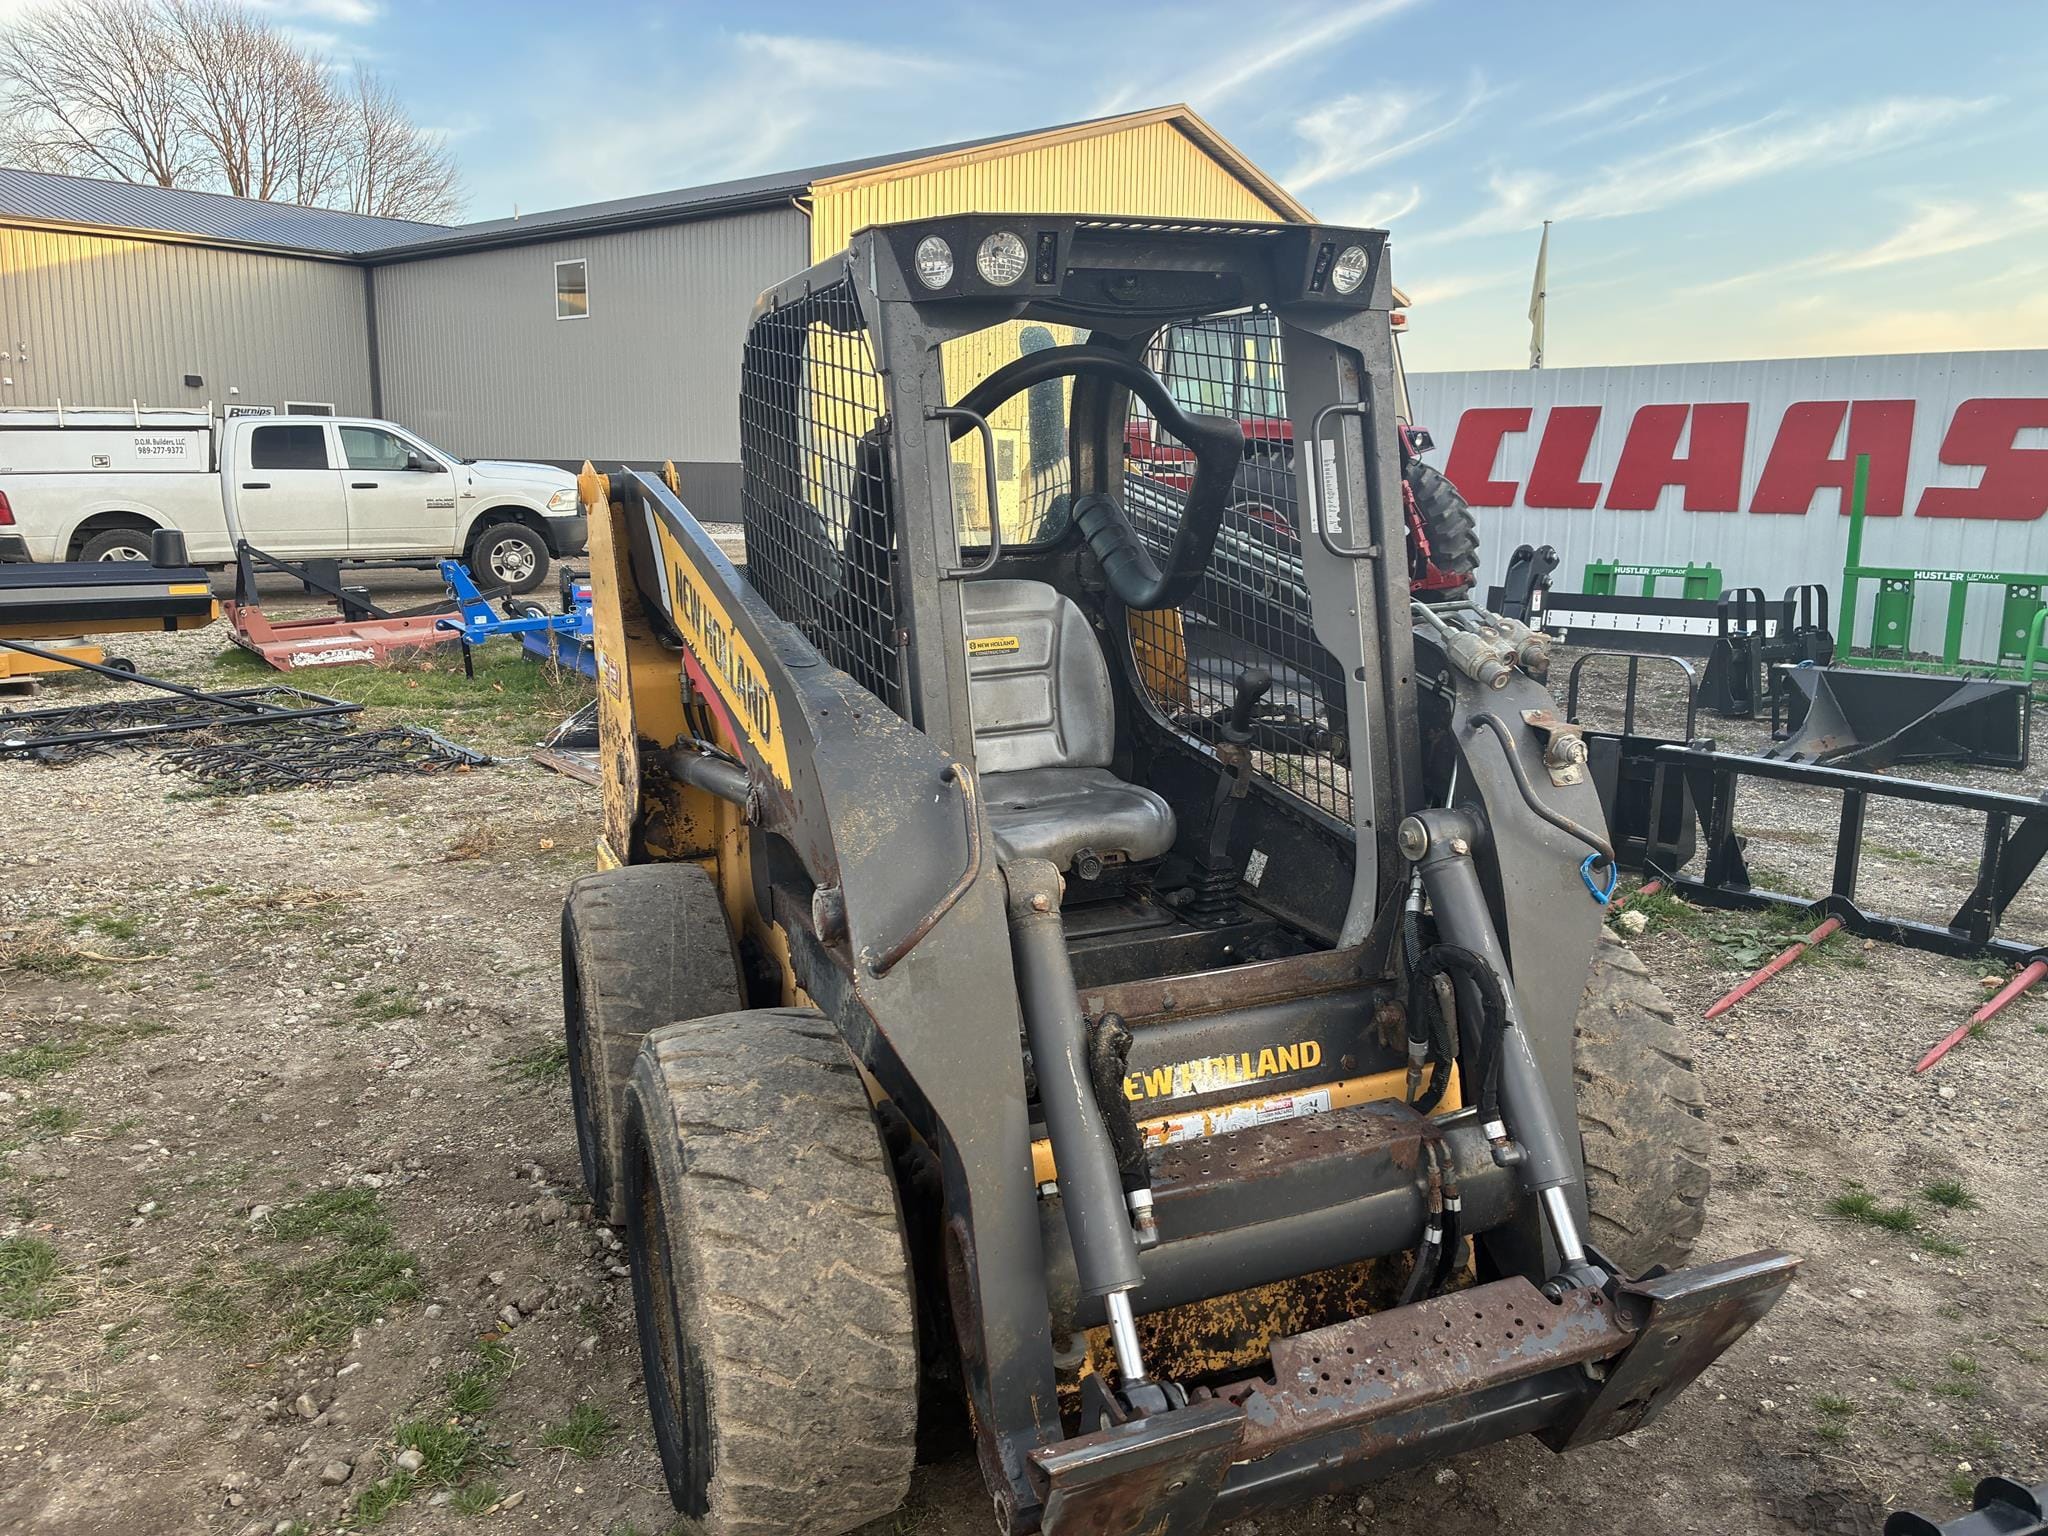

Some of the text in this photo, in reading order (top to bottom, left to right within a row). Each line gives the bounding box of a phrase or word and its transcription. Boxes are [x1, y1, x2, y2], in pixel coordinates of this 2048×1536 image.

[229, 407, 271, 417] Burnips
[138, 446, 184, 454] 989-277-9372
[1443, 398, 2048, 520] CLAAS
[1614, 566, 1650, 575] HUSTLER
[1914, 571, 2000, 581] HUSTLER LIFTMAX
[990, 639, 1015, 648] HOLLAND
[675, 561, 771, 744] NEW HOLLAND
[1123, 1040, 1321, 1101] EW HOLLAND
